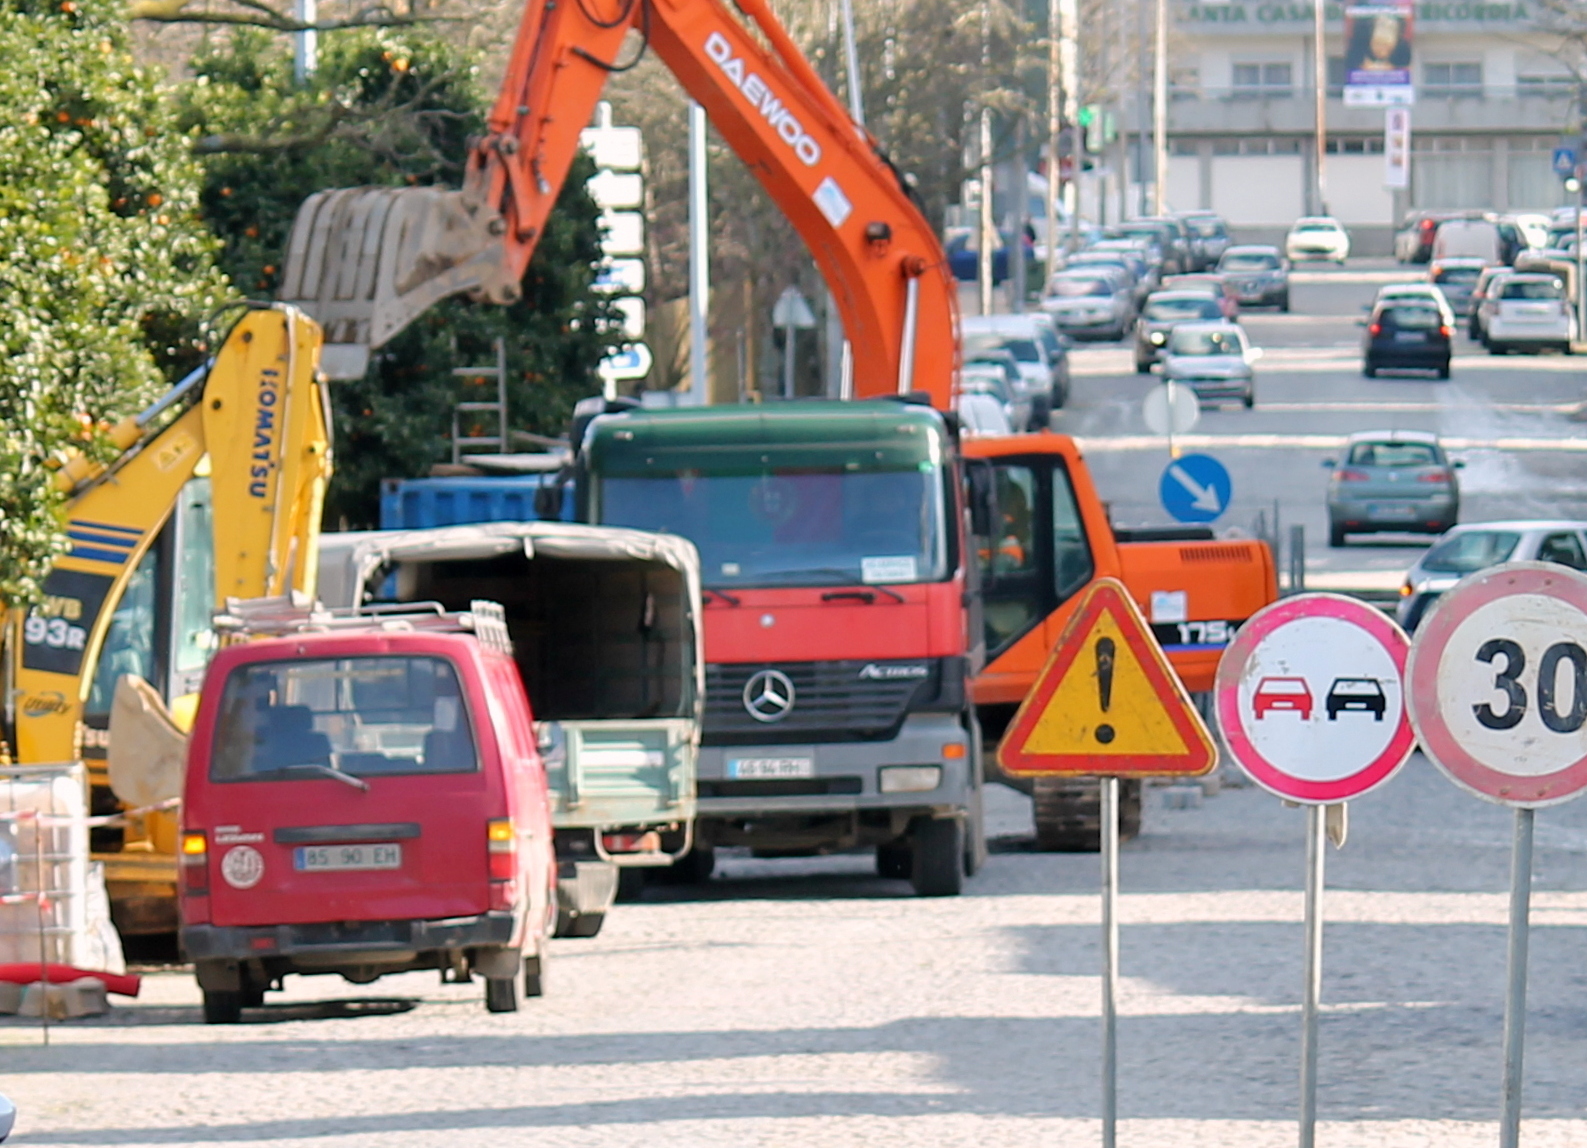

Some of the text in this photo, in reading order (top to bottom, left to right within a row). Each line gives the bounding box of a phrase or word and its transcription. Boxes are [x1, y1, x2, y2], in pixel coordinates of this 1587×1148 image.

[703, 31, 822, 167] DAEWOO
[249, 369, 280, 498] KOMATSU
[24, 616, 87, 650] 93R
